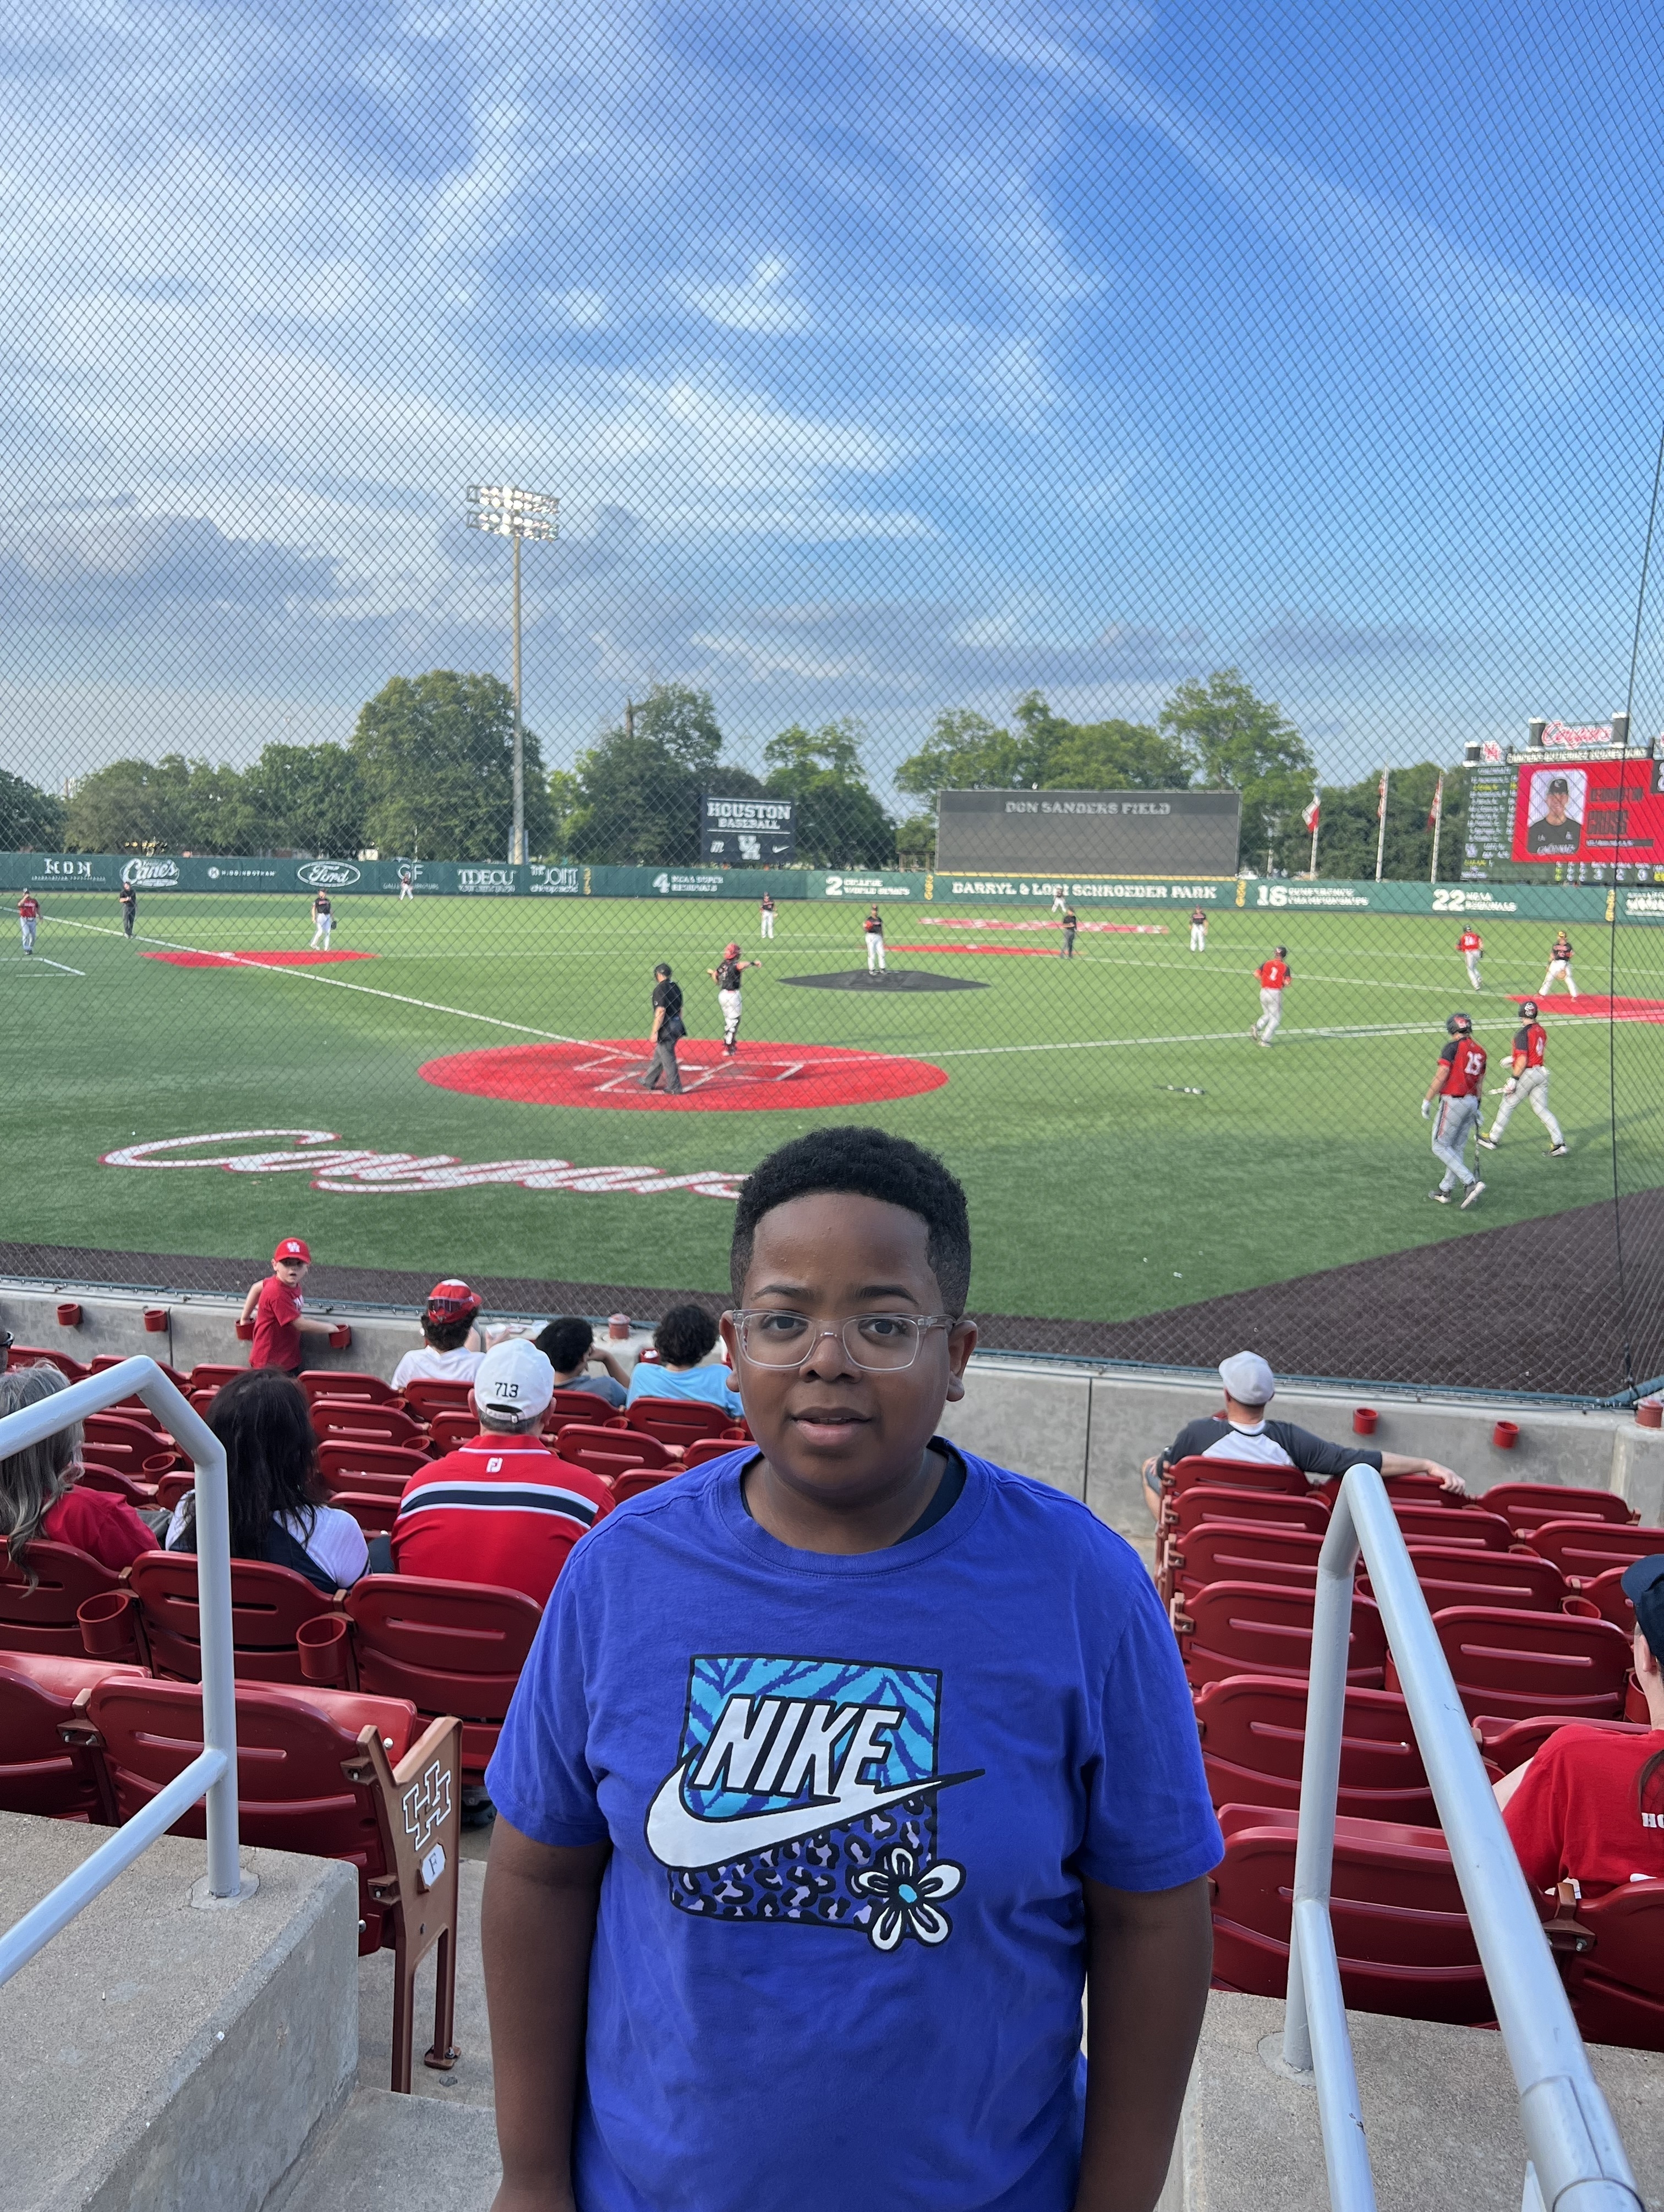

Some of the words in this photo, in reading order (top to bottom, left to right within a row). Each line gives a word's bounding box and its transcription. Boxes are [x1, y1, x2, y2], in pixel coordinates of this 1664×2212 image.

[707, 802, 791, 820] HOUSTON
[1005, 801, 1038, 813] DON
[1041, 801, 1119, 814] SANDERS
[1121, 802, 1171, 815] FIELD
[718, 817, 780, 830] BASEBALL
[309, 865, 349, 883] Ford
[457, 869, 516, 885] TDECU
[652, 872, 671, 893] 4
[825, 876, 843, 896] 2
[952, 882, 1017, 894] DARRYL
[1019, 883, 1030, 895] &
[1072, 884, 1168, 898] SCHROEDER
[1170, 886, 1218, 899] PARK
[1432, 888, 1466, 912] 22
[495, 1382, 518, 1398] 713
[691, 1695, 904, 1797] NIKE
[428, 1852, 439, 1877] F
